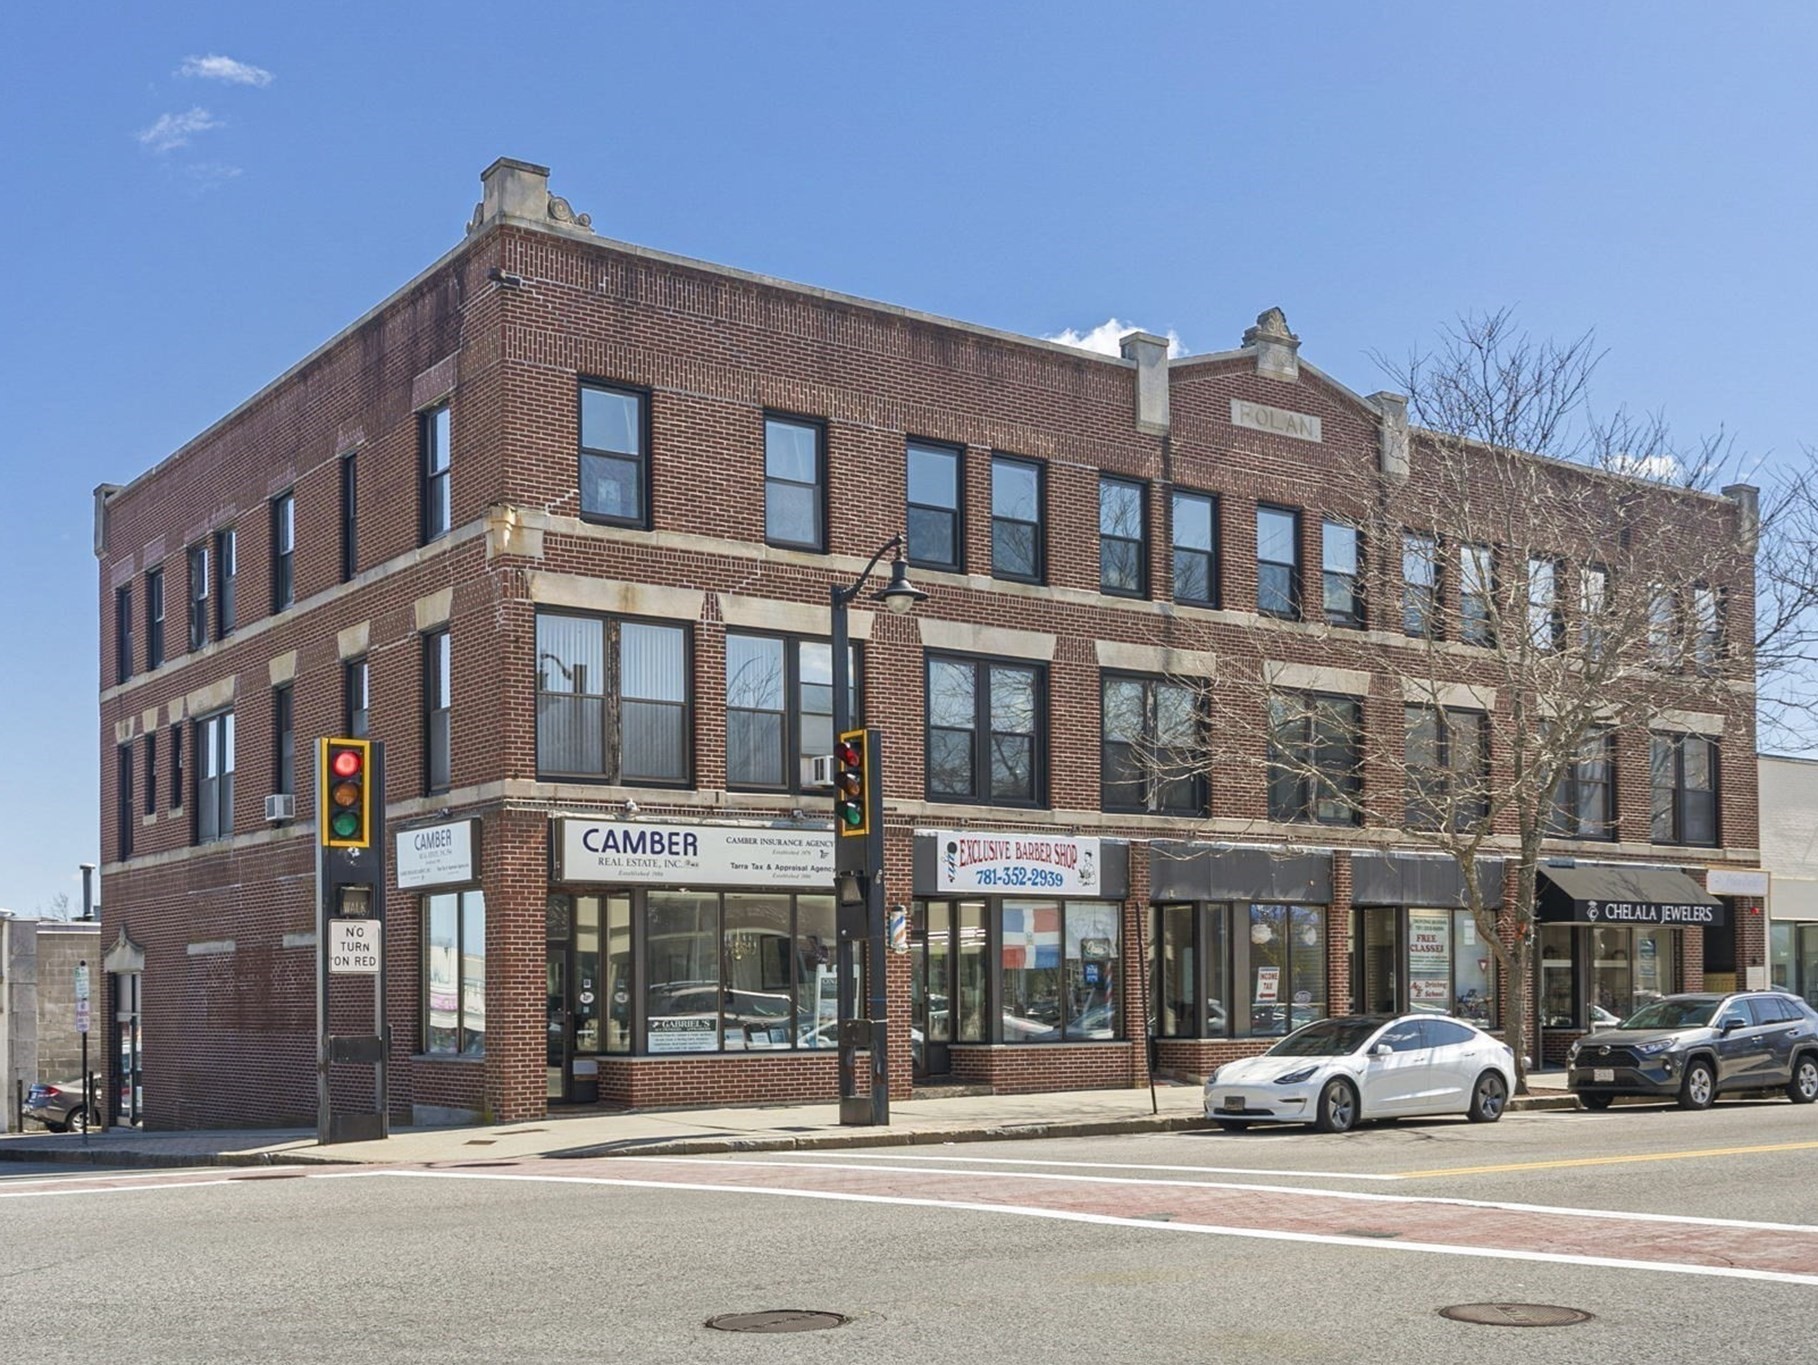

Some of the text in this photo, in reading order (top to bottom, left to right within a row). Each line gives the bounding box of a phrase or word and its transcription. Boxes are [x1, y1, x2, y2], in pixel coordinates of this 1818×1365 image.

[414, 829, 452, 851] CAMBER
[583, 828, 698, 856] CAMBER
[726, 836, 758, 845] CAMBER
[760, 838, 803, 847] INSURANCE
[959, 839, 1078, 870] EXCLUSIVE BARBER SHOP
[598, 857, 624, 867] REAL
[626, 857, 662, 869] ESTATE,
[664, 859, 684, 869] INC.
[730, 862, 748, 870] Tarra
[775, 864, 808, 872] Appraisal
[976, 867, 1063, 887] 781-352-2939
[1605, 903, 1713, 924] CHELALA JEWELERS
[346, 927, 364, 938] NO
[1416, 934, 1437, 943] FREE
[341, 942, 370, 952] TURN
[334, 956, 376, 966] ON RED
[662, 1020, 710, 1028] GABRIEL'S
